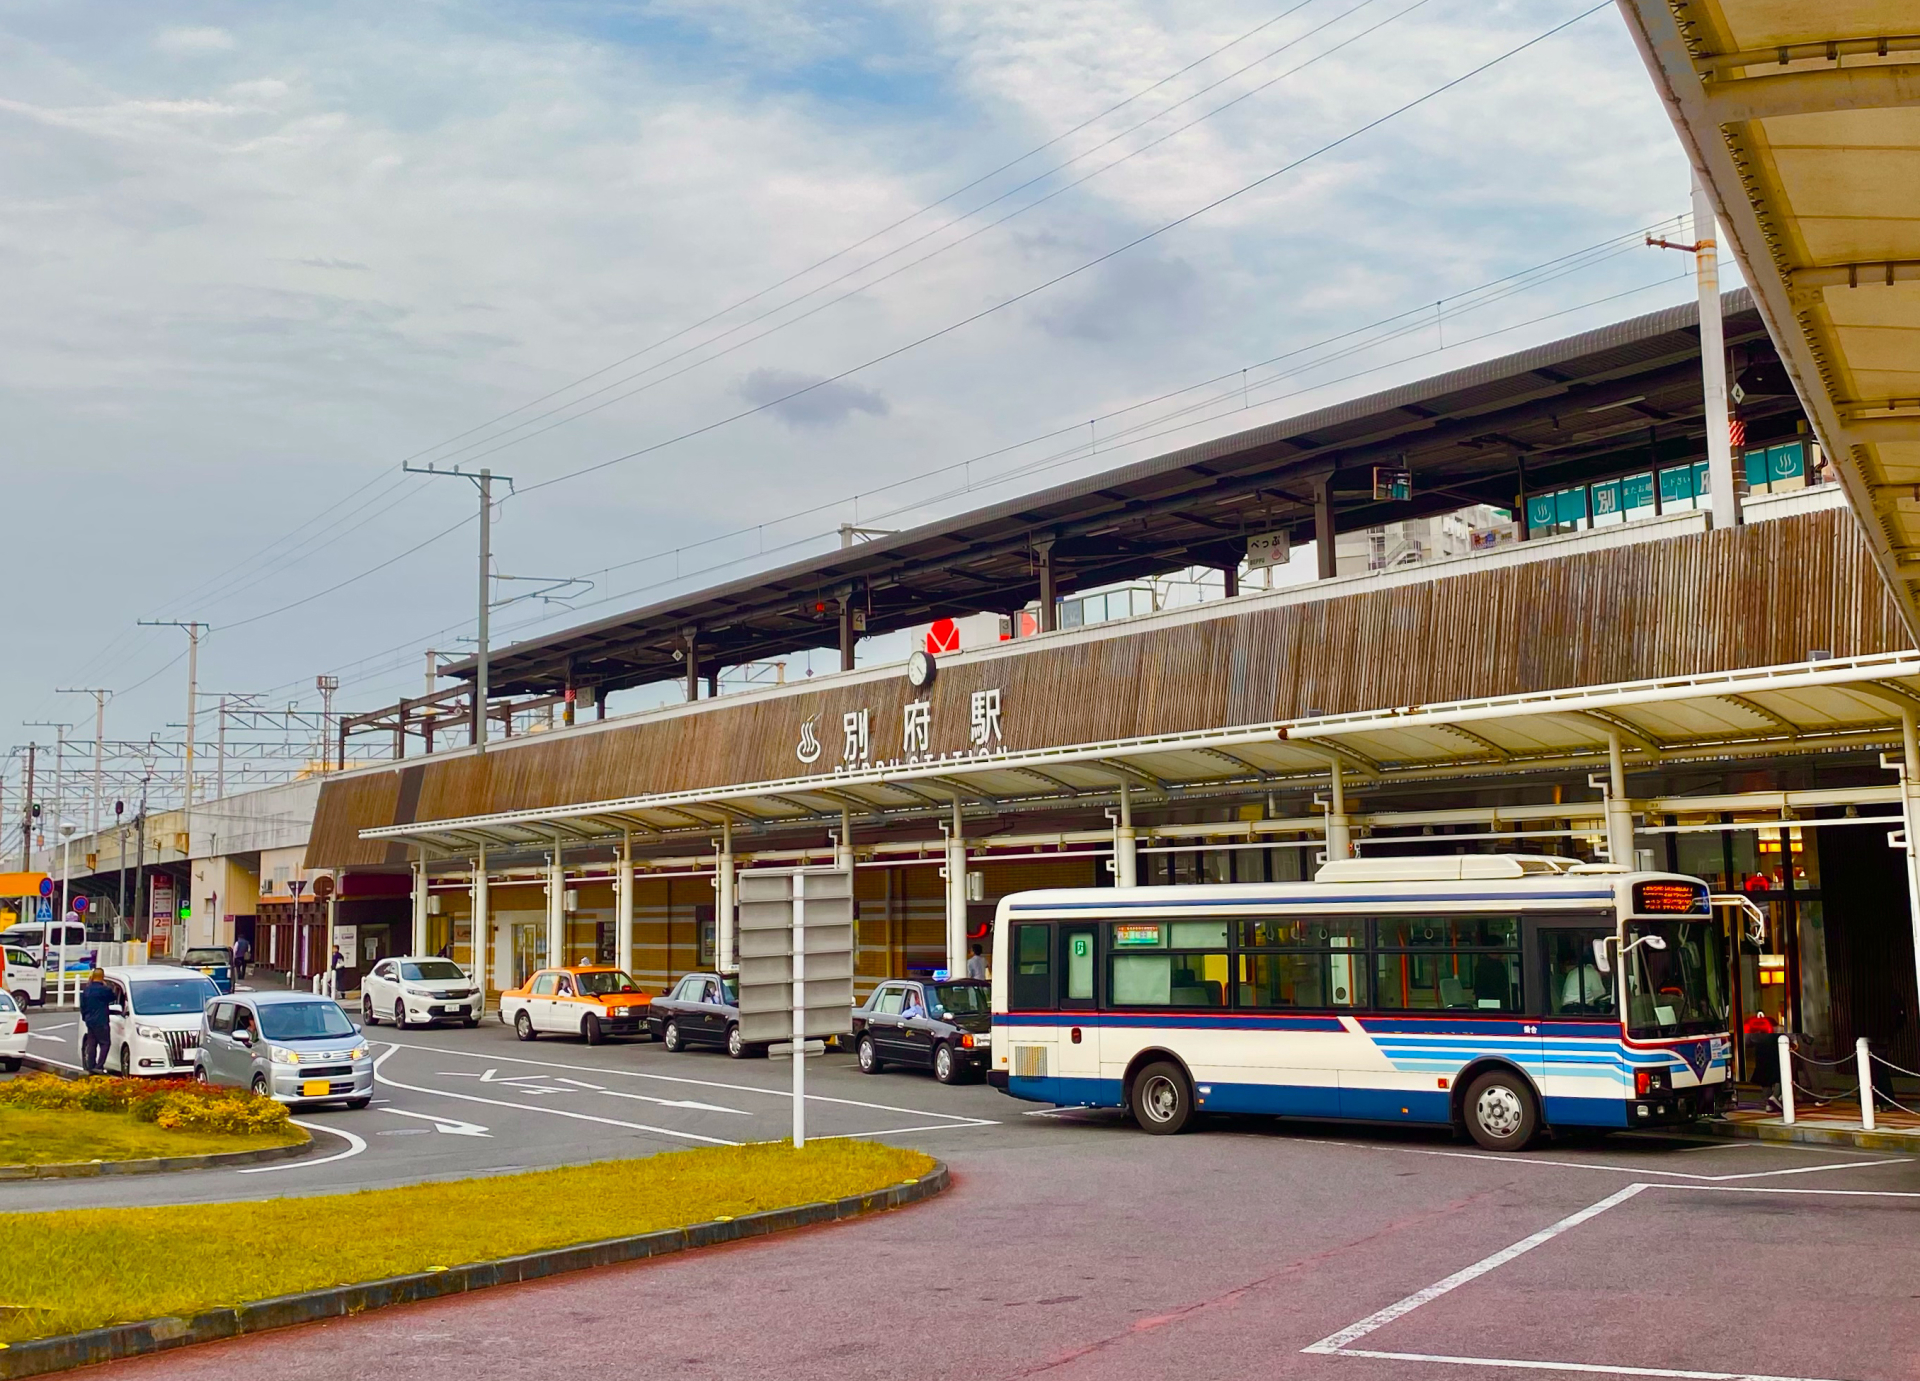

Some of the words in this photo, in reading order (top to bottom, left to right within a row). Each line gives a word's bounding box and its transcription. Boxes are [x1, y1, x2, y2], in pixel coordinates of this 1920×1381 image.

[1597, 487, 1616, 514] 別
[1250, 535, 1281, 549] べっぷ
[855, 614, 863, 624] 4
[1002, 620, 1009, 630] 3
[843, 688, 1003, 762] 別府駅
[181, 900, 190, 908] P
[154, 918, 162, 928] 2
